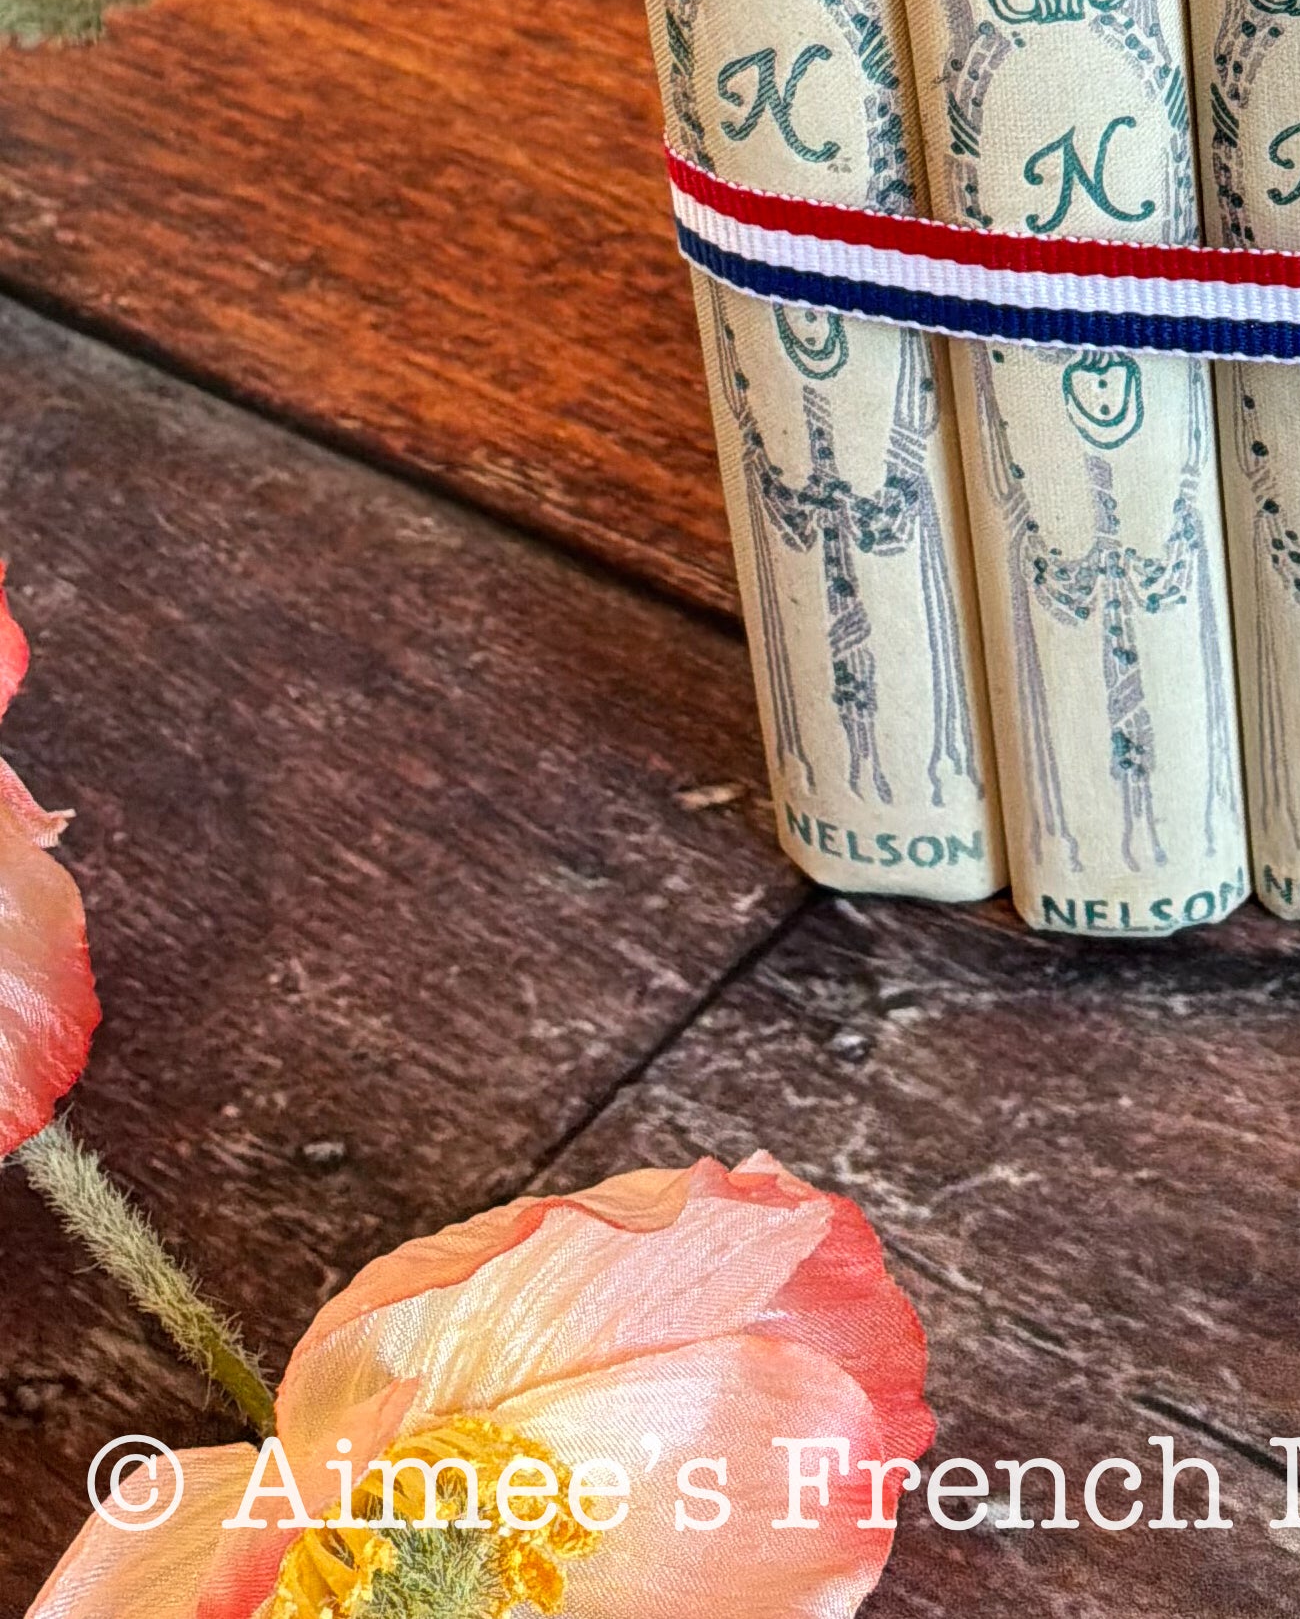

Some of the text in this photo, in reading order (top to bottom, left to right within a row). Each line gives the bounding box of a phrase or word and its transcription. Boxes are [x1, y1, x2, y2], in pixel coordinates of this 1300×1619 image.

[1024, 115, 1155, 234] N
[783, 802, 983, 868] NELSON
[1041, 867, 1245, 930] NELSON
